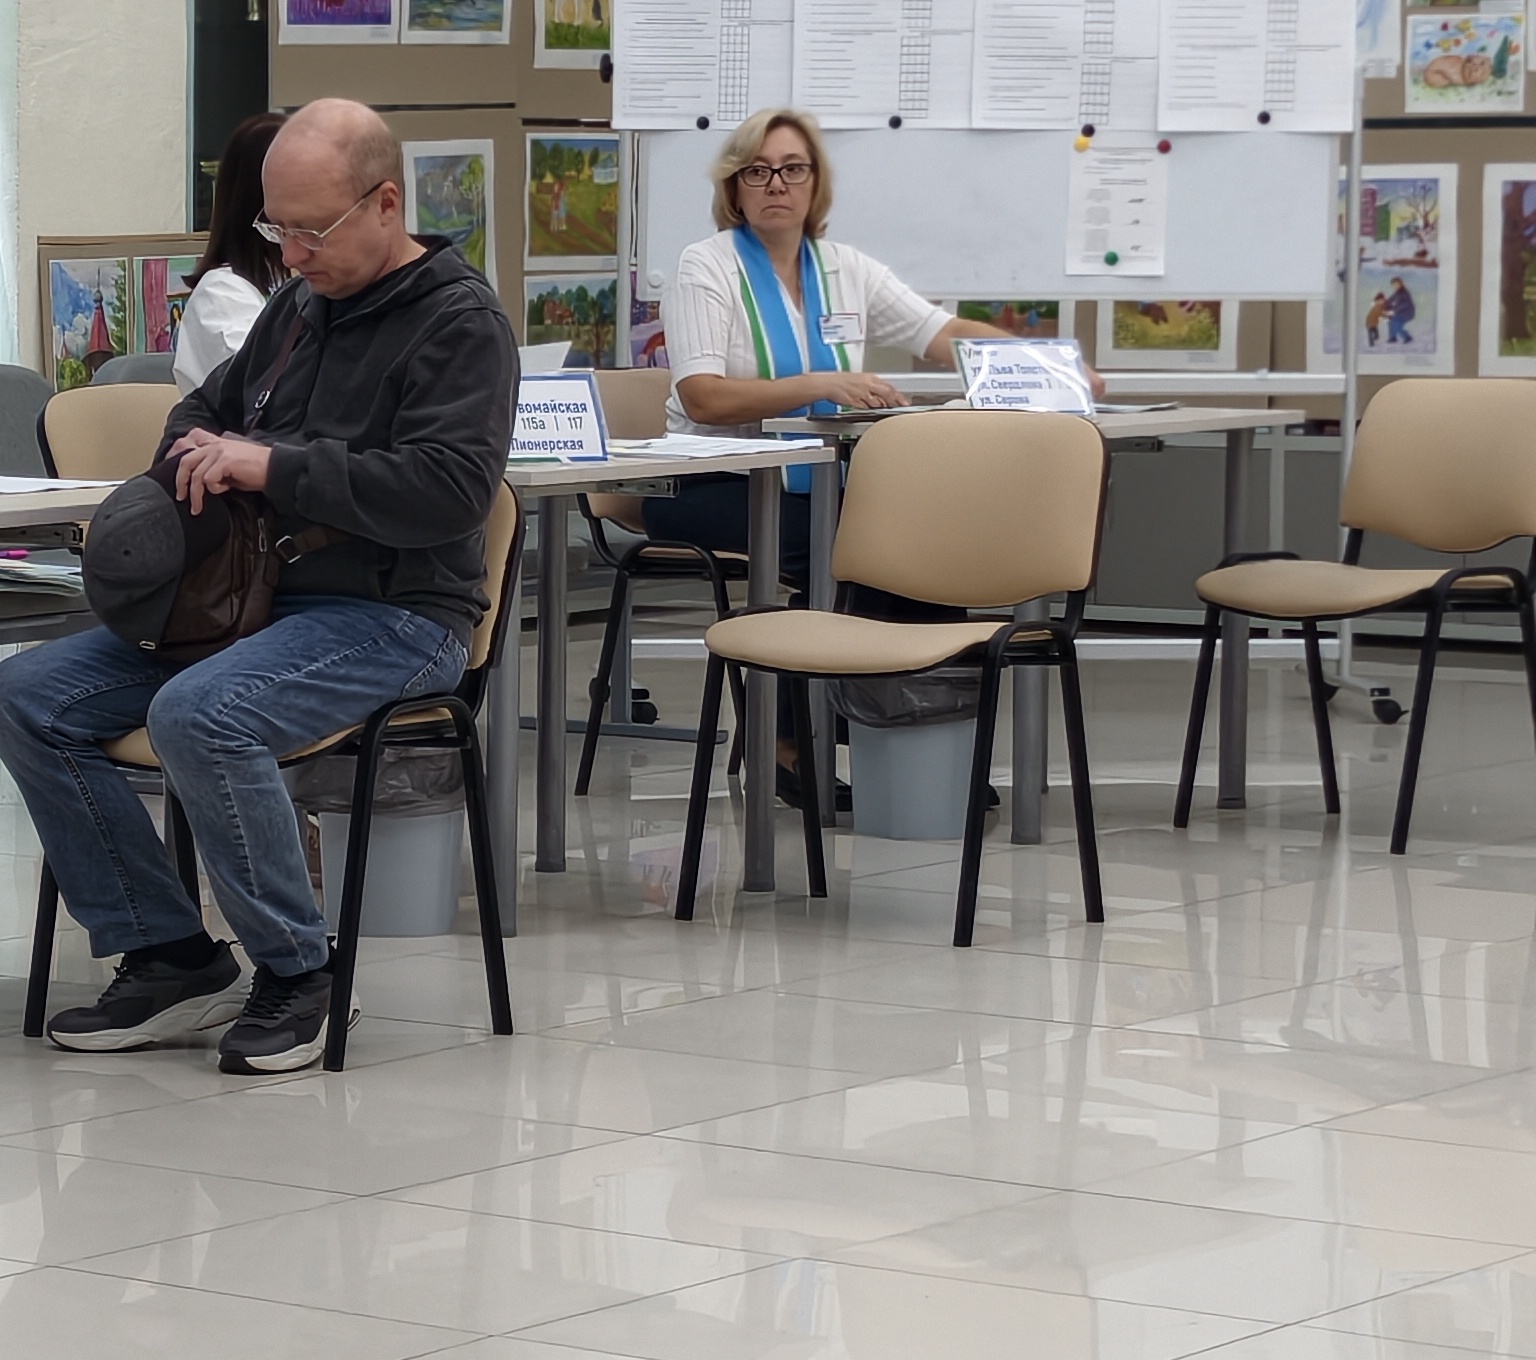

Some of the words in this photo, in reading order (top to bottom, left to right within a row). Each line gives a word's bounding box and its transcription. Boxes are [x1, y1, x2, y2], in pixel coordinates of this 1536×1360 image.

[517, 399, 588, 414] вомайская
[567, 416, 583, 430] 117
[511, 437, 584, 454] Пионерская
